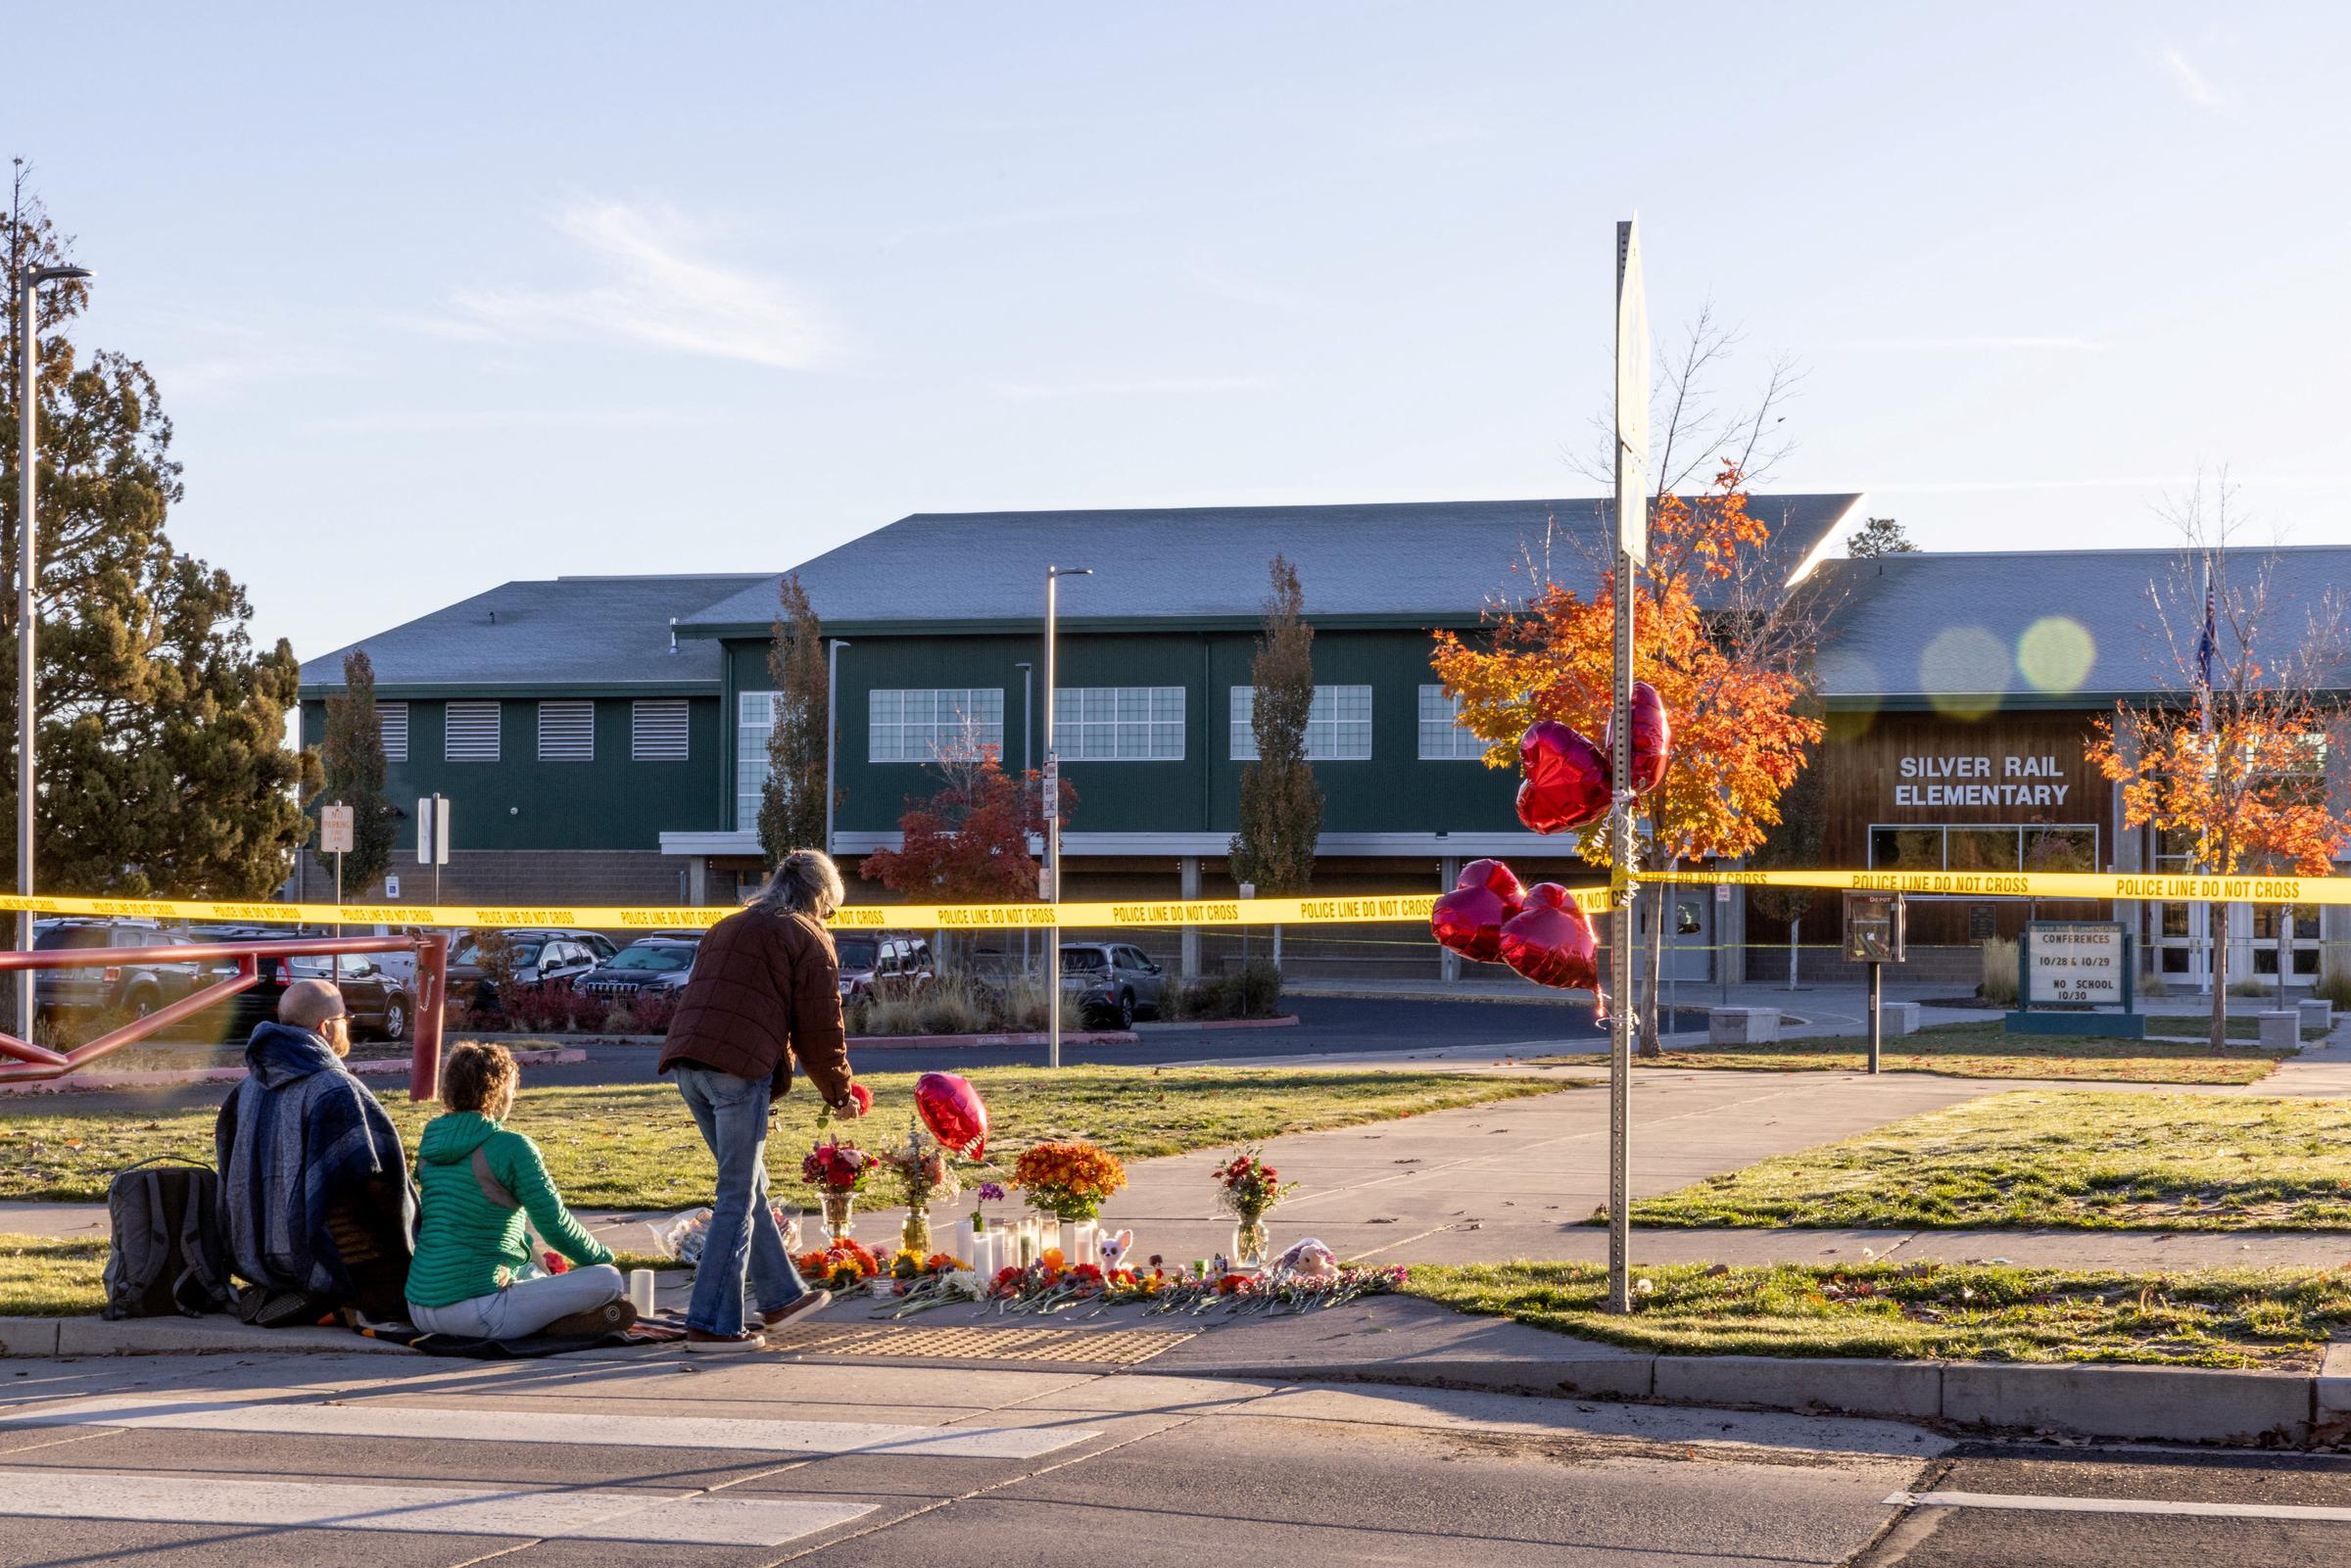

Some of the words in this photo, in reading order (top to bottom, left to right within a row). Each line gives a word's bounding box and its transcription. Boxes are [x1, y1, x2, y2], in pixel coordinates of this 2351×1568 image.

[1899, 756, 1991, 778] SILVER
[2004, 756, 2064, 778] RAIL
[1895, 784, 2069, 806] ELEMENTARY
[331, 810, 344, 820] NO
[1852, 876, 1896, 889] POLICE
[1901, 876, 1929, 890] LINE
[1934, 877, 1950, 891] DO
[1955, 877, 1982, 891] NOT
[1985, 878, 2029, 893] CROSS
[2116, 879, 2163, 896] POLICE
[2168, 879, 2196, 896] LINE
[2201, 880, 2219, 897] DO
[2225, 881, 2250, 898] NOT
[2255, 881, 2300, 899] CROSS
[1587, 892, 1608, 909] NOT
[275, 908, 302, 919] CROSS
[340, 909, 367, 921] POLICE
[365, 909, 382, 921] LINE
[381, 909, 395, 922] DO
[393, 910, 409, 922] NOT
[407, 910, 434, 922] CROSS
[1113, 907, 1144, 923] POLICE
[1147, 907, 1169, 922] LINE
[1171, 906, 1184, 922] DO
[1186, 906, 1204, 921] NOT
[1207, 905, 1238, 921] CROSS
[1301, 902, 1334, 919] POLICE
[1337, 902, 1360, 919] LINE
[1362, 901, 1376, 918] DO
[1379, 900, 1399, 917] NOT
[1402, 899, 1434, 917] CROSS
[476, 911, 504, 923] POLICE
[504, 911, 521, 924] LINE
[521, 911, 534, 924] DO
[531, 911, 547, 924] NOT
[548, 911, 575, 924] CROSS
[620, 911, 648, 925] POLICE
[650, 911, 667, 925] LINE
[667, 911, 681, 925] DO
[681, 911, 696, 925] NOT
[839, 910, 854, 925] NOT
[856, 910, 885, 925] CROSS
[937, 909, 968, 925] POLICE
[970, 909, 990, 924] LINE
[991, 909, 1004, 924] DO
[1006, 909, 1023, 924] NOT
[1026, 908, 1056, 924] CROSS
[2042, 934, 2110, 944] CONFERENCES
[2039, 957, 2068, 967] 10/28
[2071, 958, 2078, 967] &
[2082, 957, 2110, 967] 10/29
[2053, 979, 2067, 988] NO
[2076, 979, 2114, 989] SCHOOL
[2058, 991, 2087, 1000] 10/30
